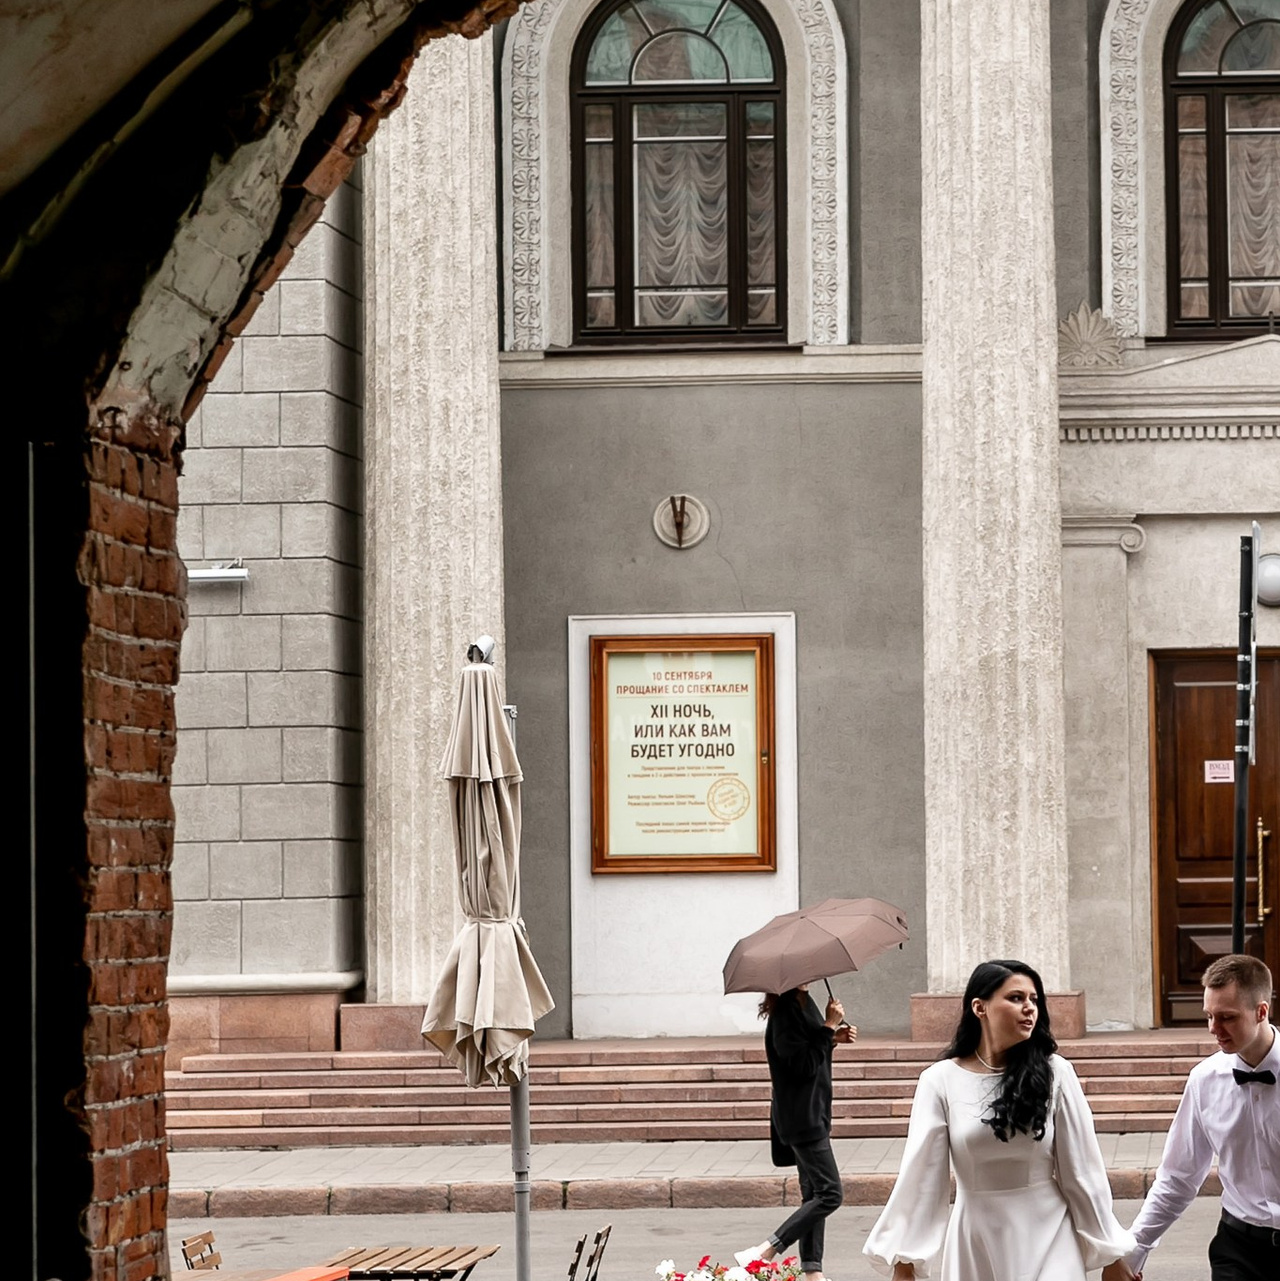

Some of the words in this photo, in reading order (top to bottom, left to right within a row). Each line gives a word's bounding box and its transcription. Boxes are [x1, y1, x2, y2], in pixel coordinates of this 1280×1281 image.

[653, 672, 662, 680] 10
[665, 671, 712, 680] СЕНТЯБРЯ
[617, 685, 669, 695] ПРОЩАНИЕ
[672, 685, 684, 693] СО
[687, 684, 749, 694] СПЕКТАКЛЕМ
[651, 705, 668, 718] XII
[673, 704, 715, 720] НОЧЬ,
[634, 724, 664, 738] ИЛИ
[669, 724, 696, 737] КАК
[701, 724, 731, 737] ВАМ
[631, 744, 674, 759] БУДЕТ
[679, 743, 735, 758] УГОДНО
